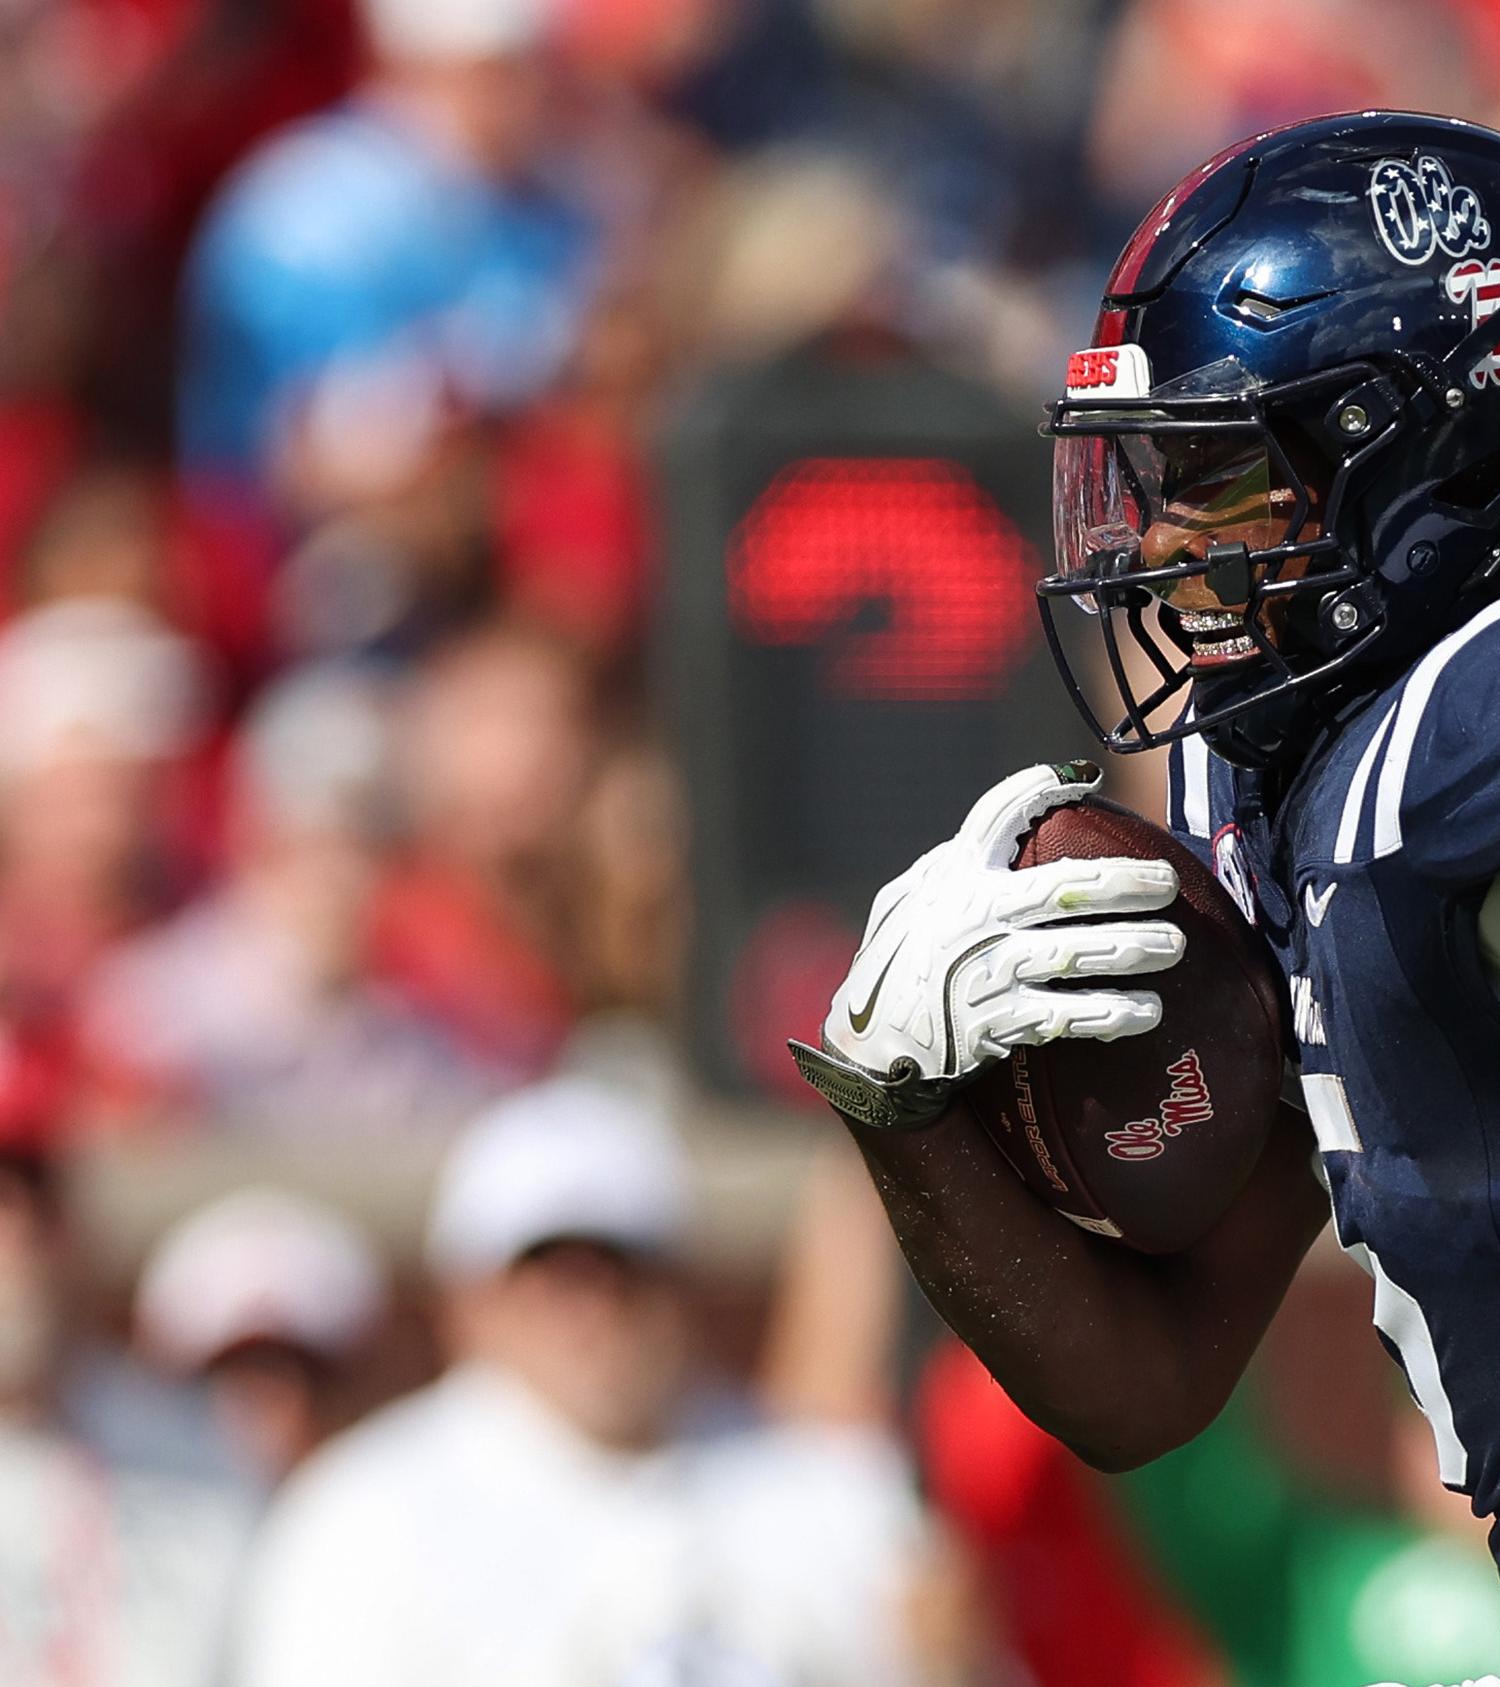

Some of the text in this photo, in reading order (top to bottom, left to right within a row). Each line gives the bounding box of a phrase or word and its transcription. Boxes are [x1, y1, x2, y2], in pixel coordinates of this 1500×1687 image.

[1371, 156, 1491, 266] Ole
[1104, 1048, 1214, 1161] Ole Miss
